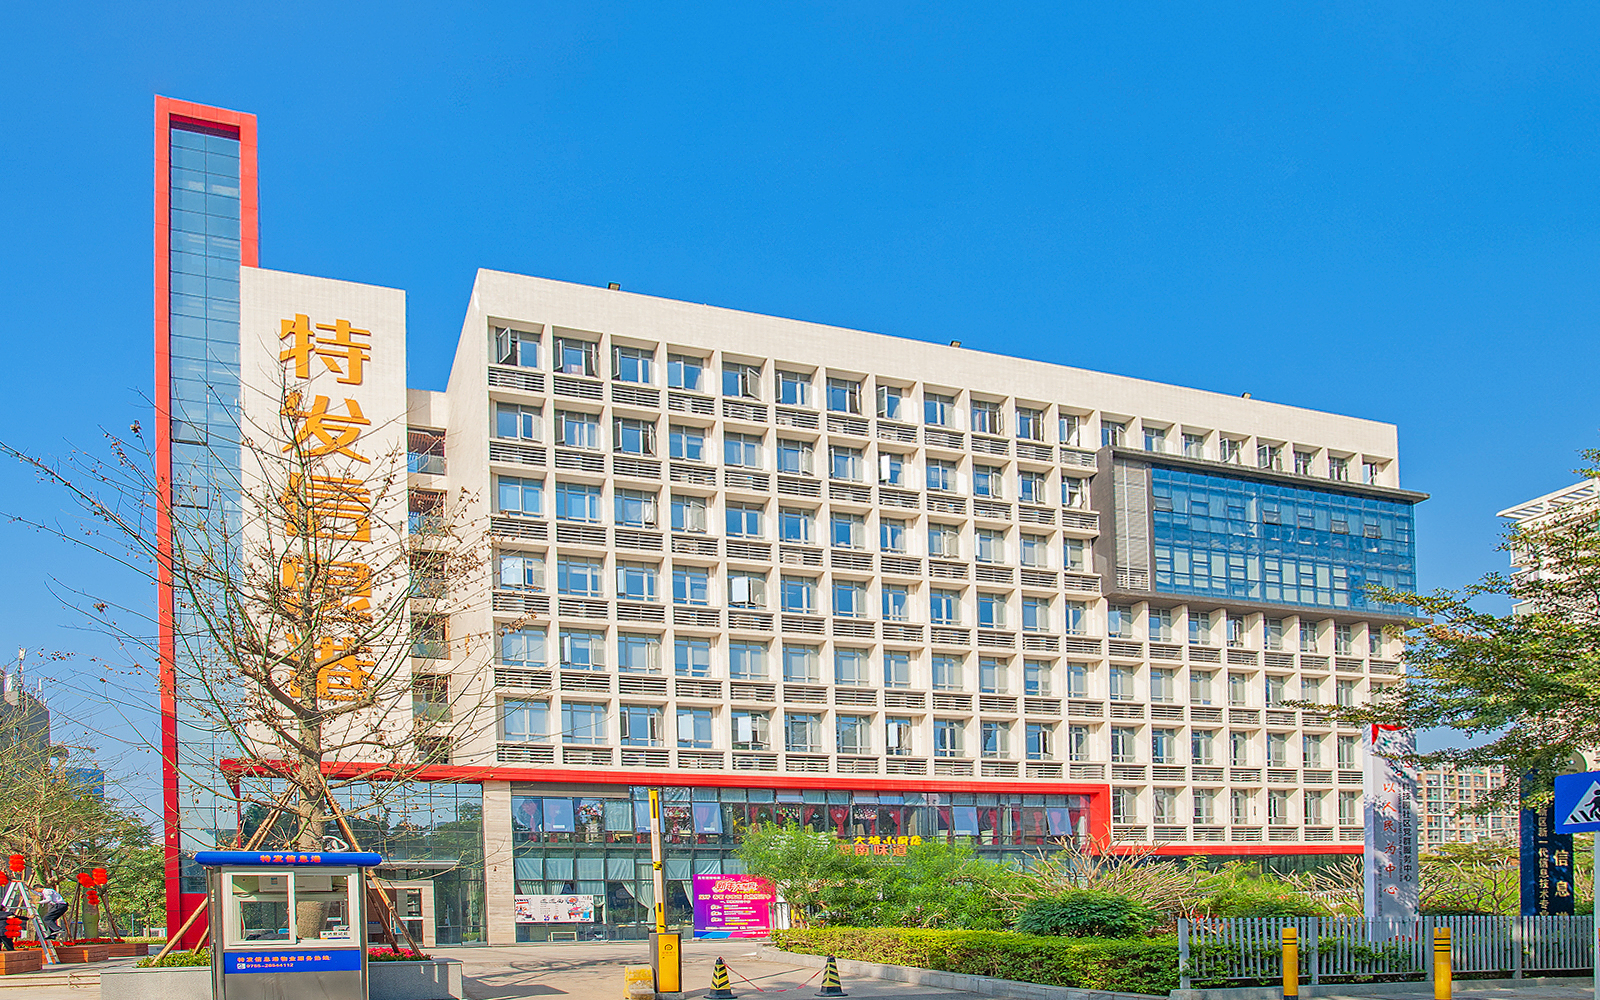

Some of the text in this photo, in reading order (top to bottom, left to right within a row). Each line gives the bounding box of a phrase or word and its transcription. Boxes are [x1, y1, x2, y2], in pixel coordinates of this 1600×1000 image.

[279, 313, 374, 701] 特发信息港
[259, 854, 322, 863] 特发信息港
[1382, 782, 1398, 895] 以人民为中心
